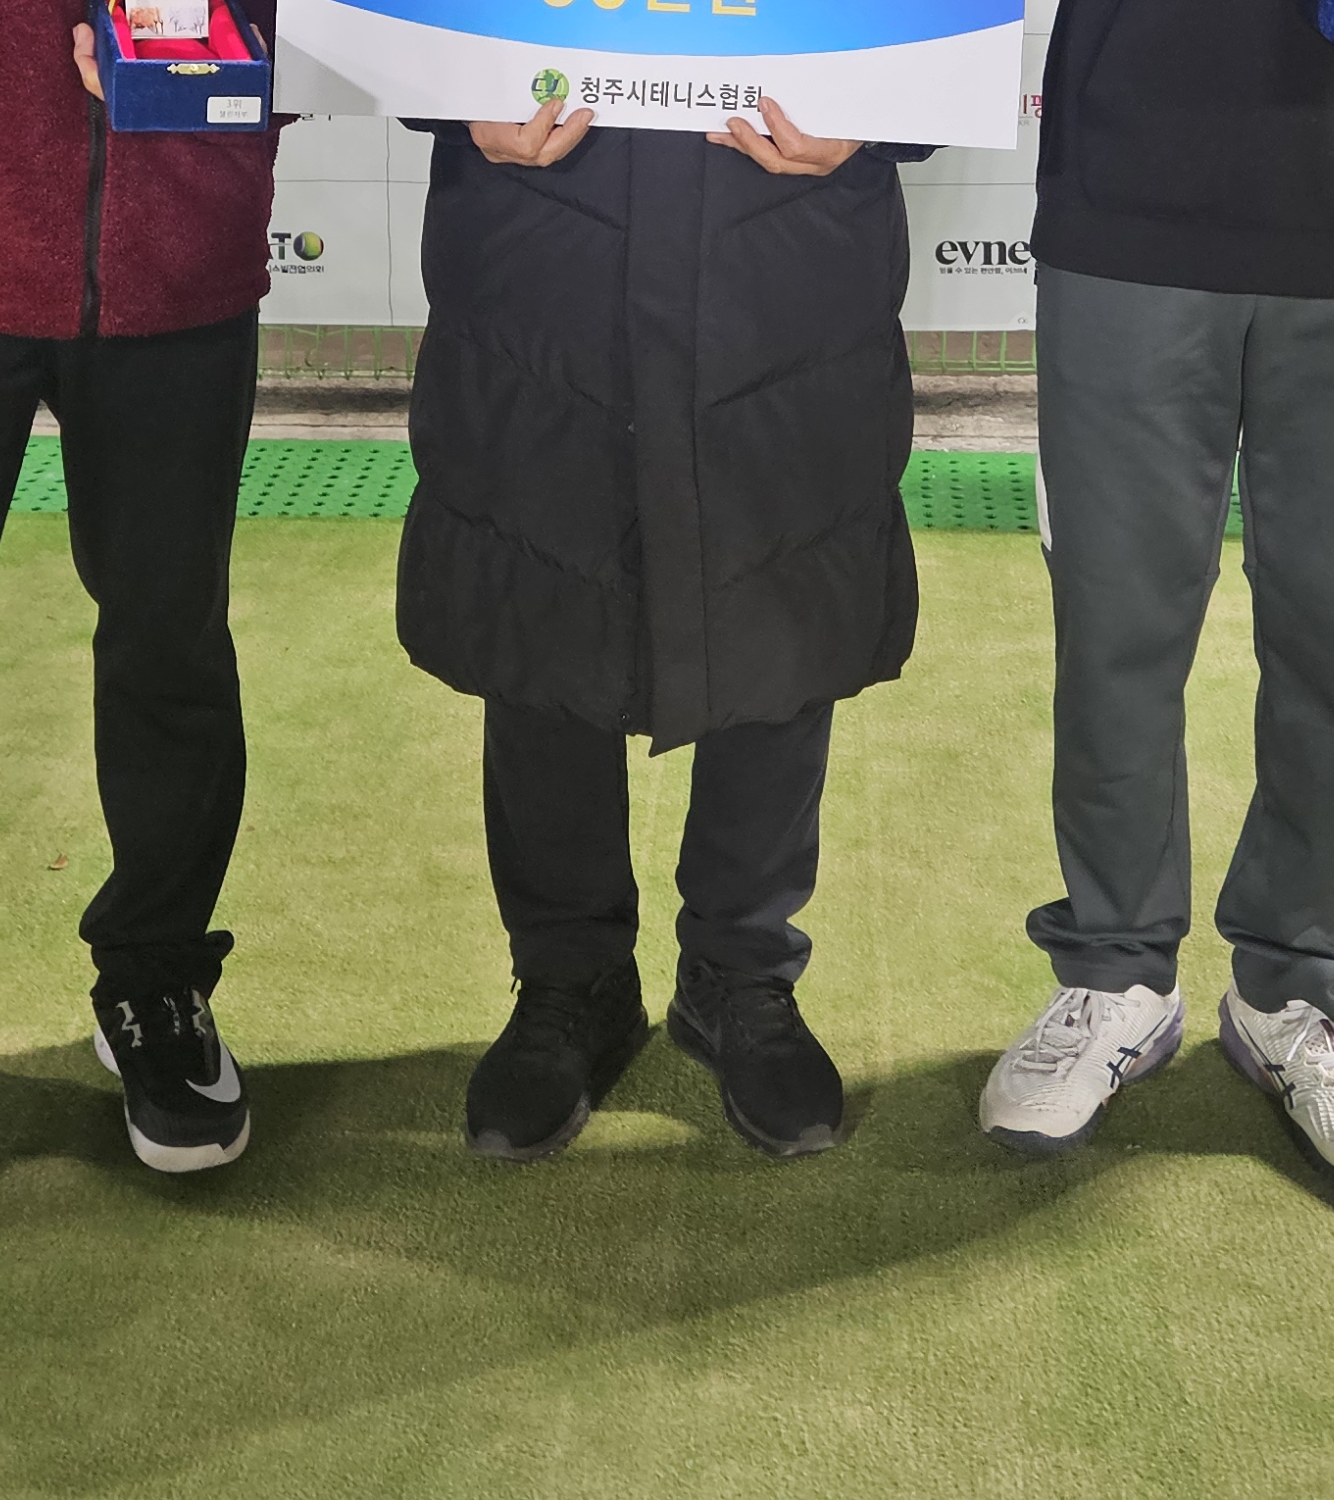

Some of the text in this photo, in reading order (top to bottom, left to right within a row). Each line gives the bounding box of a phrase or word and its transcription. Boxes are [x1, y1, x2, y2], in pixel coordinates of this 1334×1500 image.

[226, 99, 243, 109] 3위
[579, 76, 762, 113] 청주시테니스협회
[935, 240, 1032, 266] evne
